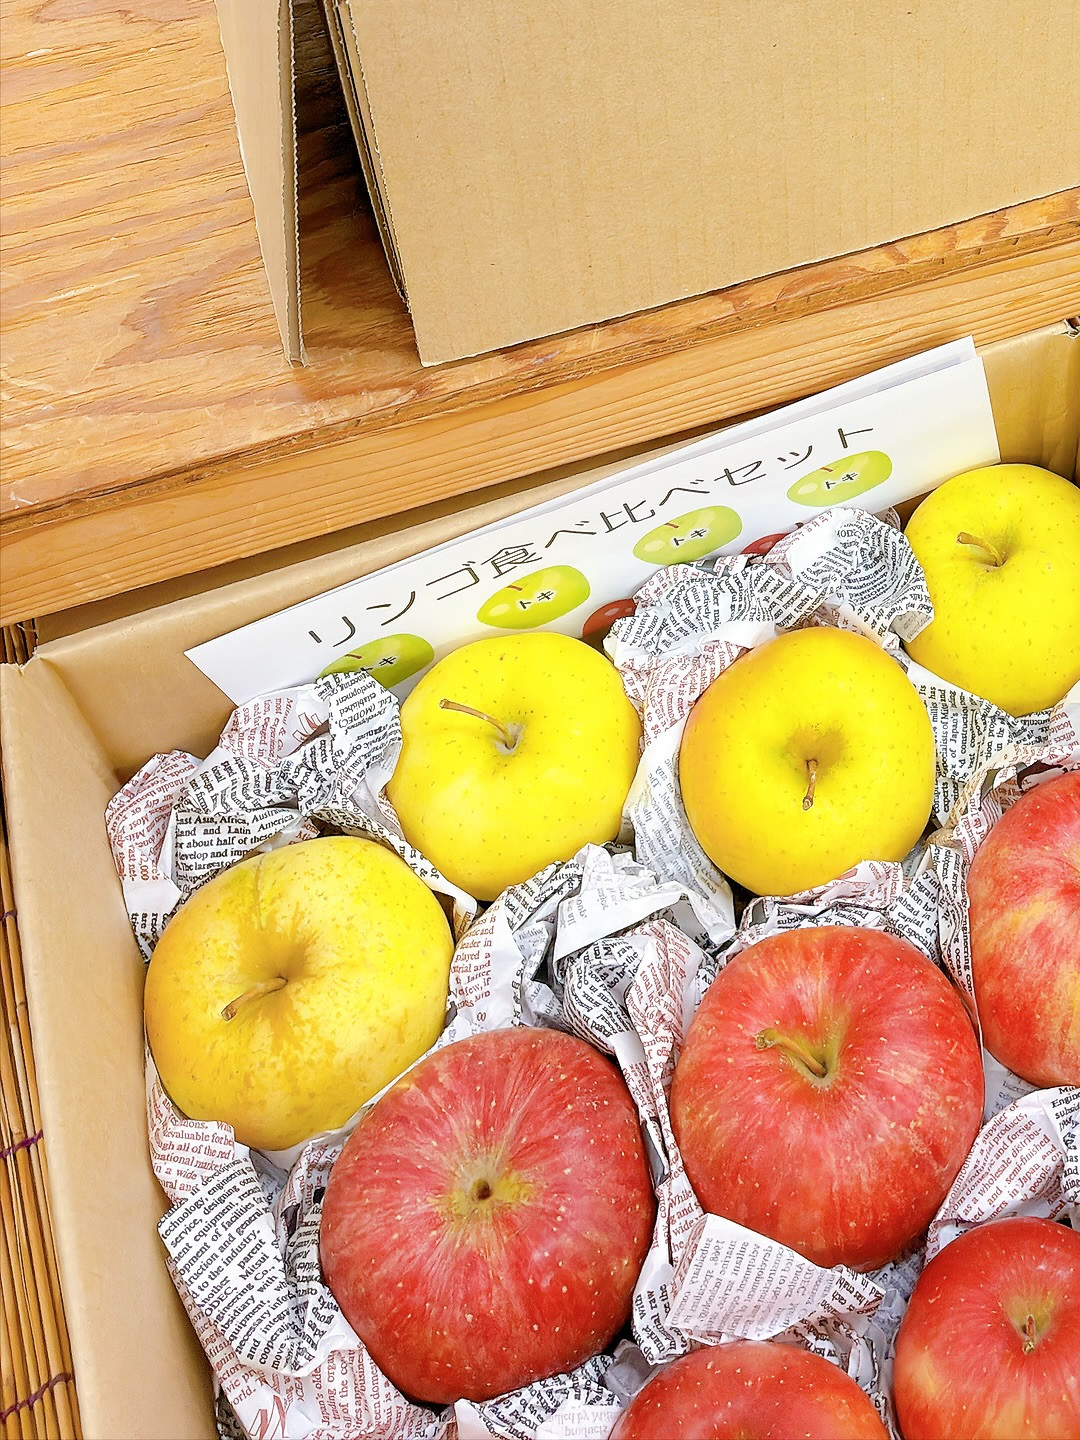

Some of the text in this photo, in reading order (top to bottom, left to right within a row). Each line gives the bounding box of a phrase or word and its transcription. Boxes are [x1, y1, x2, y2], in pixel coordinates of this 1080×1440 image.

[826, 471, 858, 490] トキ
[308, 425, 874, 648] リンゴ食べ比べセット
[673, 528, 707, 547] トキ
[518, 590, 554, 610] トキ
[203, 813, 294, 835] and Latin America
[186, 838, 213, 849] about
[216, 836, 235, 846] half
[237, 836, 248, 844] of
[210, 849, 228, 859] and
[455, 951, 480, 963] played
[474, 960, 491, 972] and
[982, 1112, 1008, 1145] supplier
[992, 1113, 1028, 1145] products,
[994, 1118, 1036, 1161] and foreign
[192, 1144, 203, 1153] of
[204, 1146, 217, 1157] the
[978, 1127, 1042, 1197] wholesale distribu-
[176, 1169, 198, 1180] wide
[987, 1134, 1052, 1206] and semi-finished
[1008, 1144, 1057, 1199] in Japan and
[1029, 1164, 1052, 1193] people
[162, 1197, 209, 1239] technology,
[170, 1185, 240, 1248] service, designing
[193, 1202, 239, 1242] equipment,
[211, 1201, 255, 1242] of facilities
[218, 1207, 264, 1254] and general
[198, 1229, 261, 1292] to the industry.
[236, 1238, 267, 1270] parent
[239, 1251, 270, 1281] Mitsui
[256, 1275, 279, 1294] with
[234, 1309, 271, 1355] necessary
[246, 1338, 260, 1360] and
[271, 1342, 287, 1370] move
